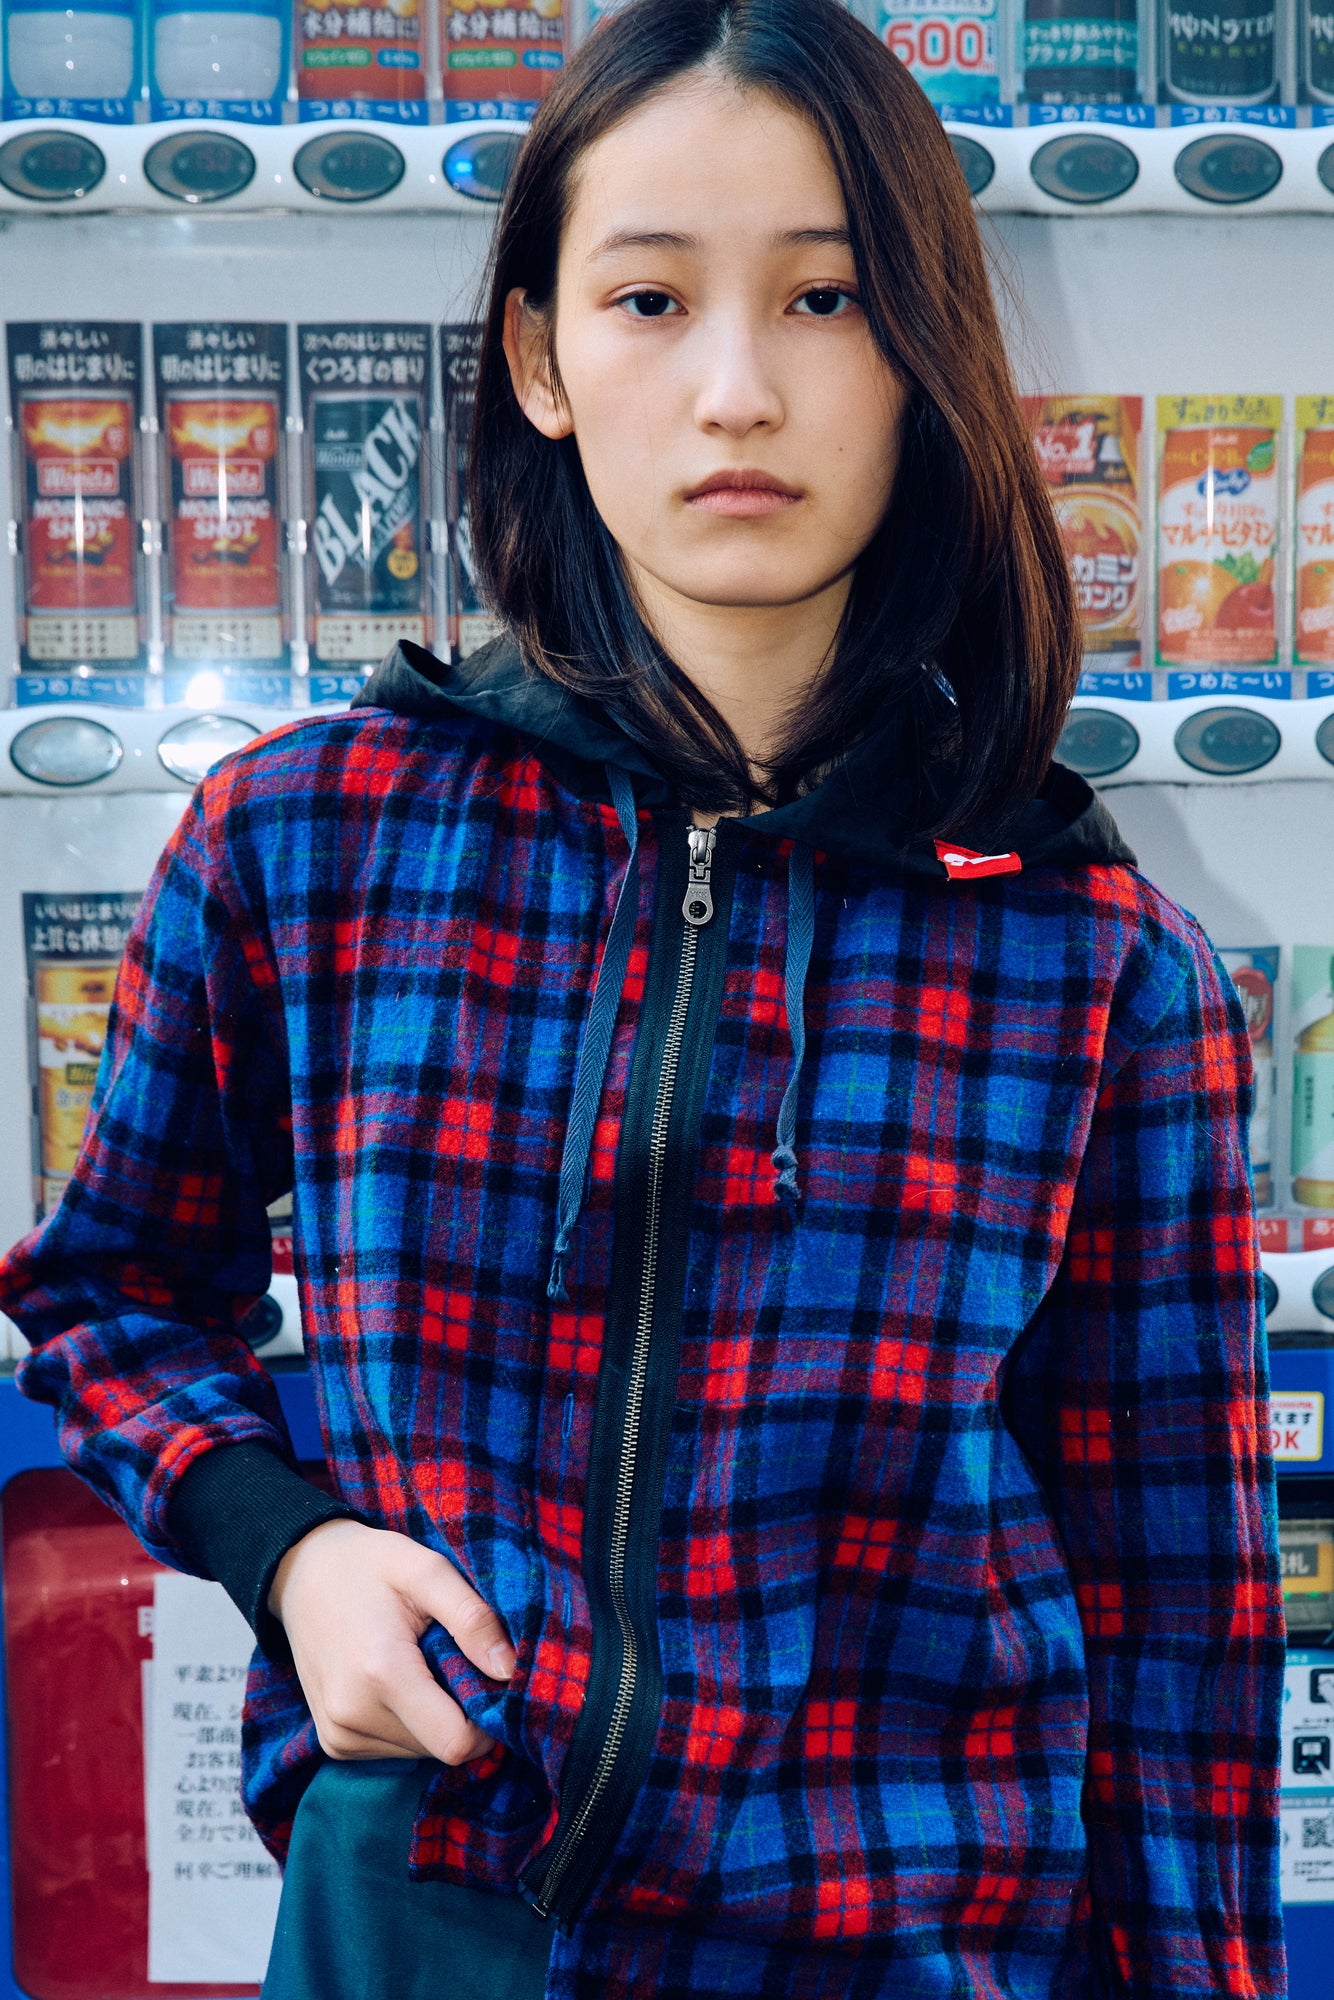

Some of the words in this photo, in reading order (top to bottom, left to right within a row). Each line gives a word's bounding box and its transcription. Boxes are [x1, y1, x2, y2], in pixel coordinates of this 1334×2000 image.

[887, 22, 981, 68] 600
[15, 354, 135, 382] 朝のはじまりに
[161, 354, 281, 382] 朝のはじまりに
[306, 356, 425, 384] くつろぎの香り
[313, 396, 421, 586] BLACK
[1178, 674, 1282, 690] つめた〜い
